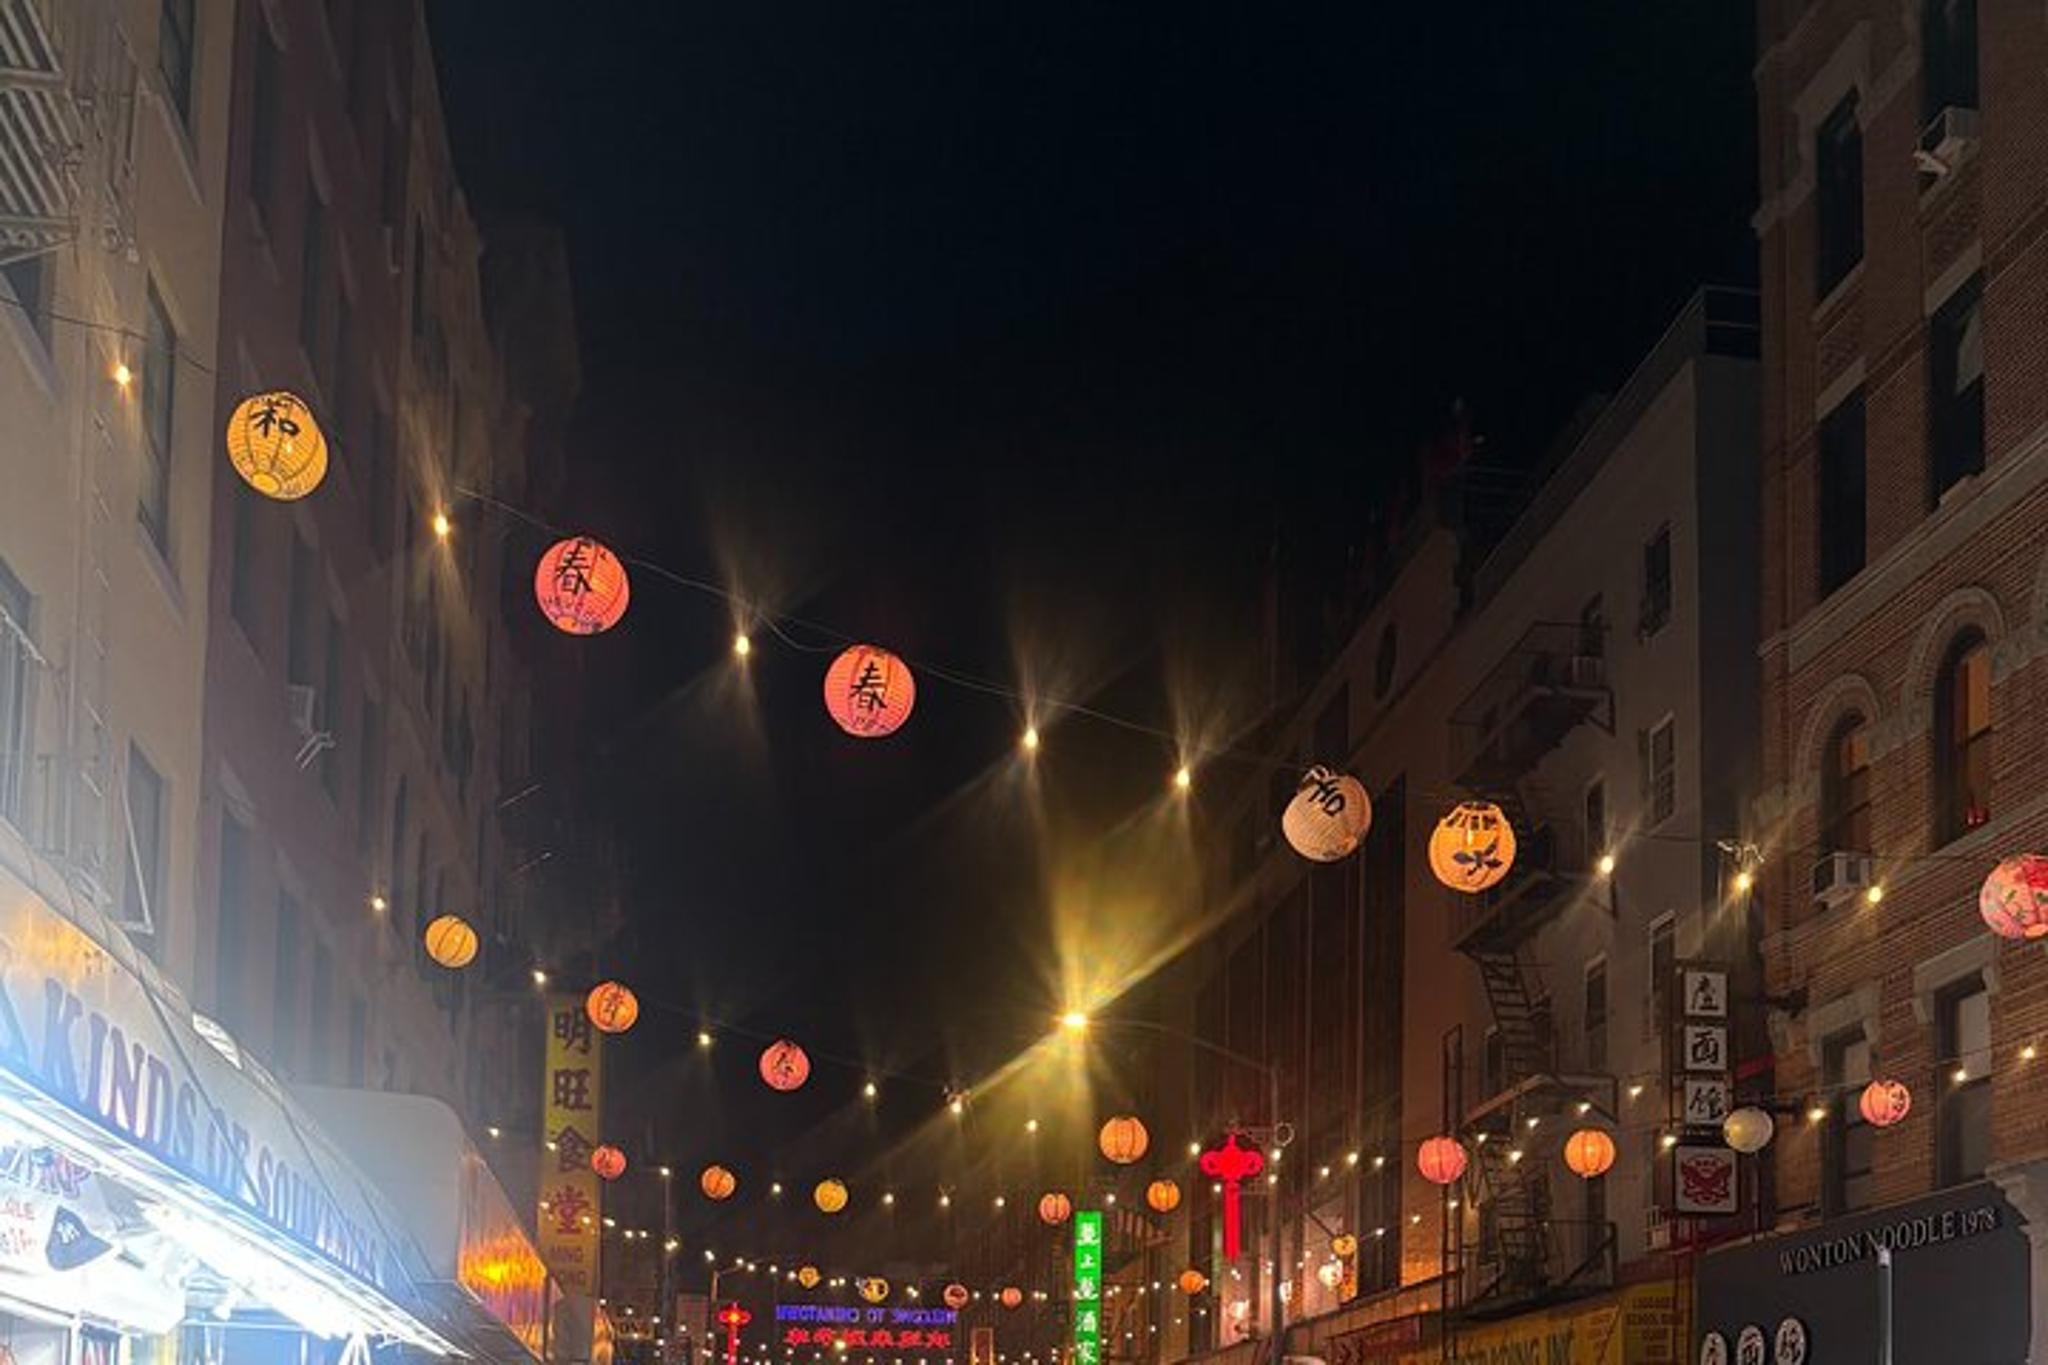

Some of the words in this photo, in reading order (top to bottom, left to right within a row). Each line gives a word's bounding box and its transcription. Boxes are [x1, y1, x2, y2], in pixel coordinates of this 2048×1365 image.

[249, 398, 300, 438] 和
[555, 543, 592, 595] 春
[849, 660, 888, 712] 春
[45, 977, 198, 1160] KINDS
[1778, 1231, 1862, 1275] WONTON
[1865, 1210, 1956, 1254] NOODLE
[1961, 1205, 1996, 1236] 1978
